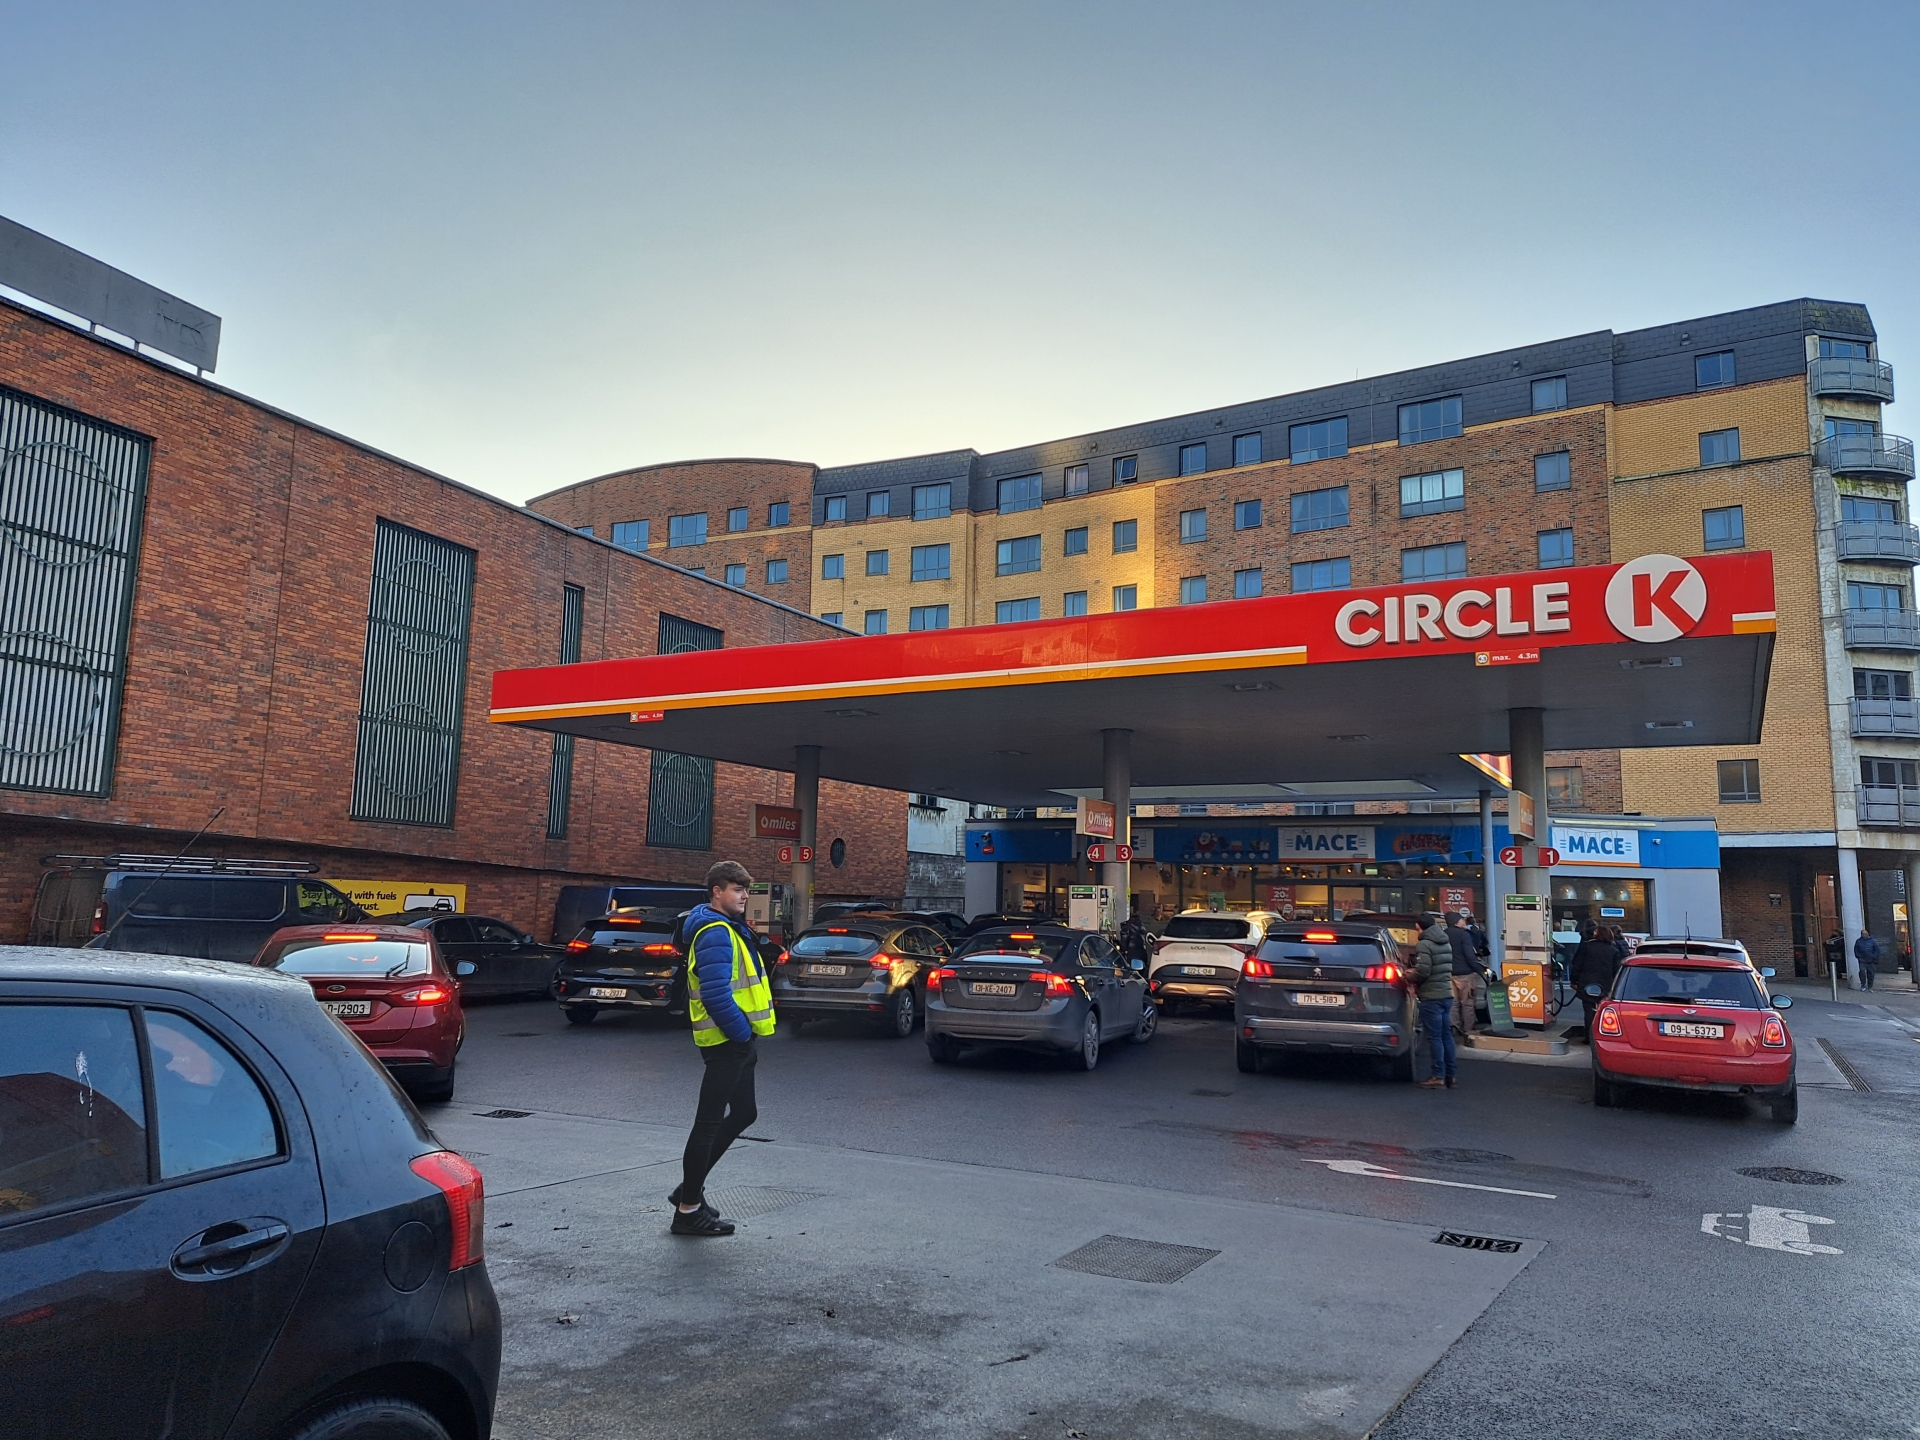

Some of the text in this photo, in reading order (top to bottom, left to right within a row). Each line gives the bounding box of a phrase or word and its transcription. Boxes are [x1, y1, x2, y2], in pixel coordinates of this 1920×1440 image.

[1335, 569, 1698, 646] CIRCLE K
[1518, 652, 1538, 660] 4.3m
[1295, 834, 1358, 851] MACE
[1568, 835, 1625, 855] MACE
[781, 849, 788, 860] 6
[803, 848, 810, 860] 5
[1091, 847, 1100, 859] 4
[1120, 847, 1129, 859] 3
[1505, 850, 1516, 864] 2
[1546, 850, 1554, 864] 1
[302, 890, 323, 900] Stay
[354, 890, 375, 900] with
[377, 891, 397, 901] fuels
[358, 901, 379, 911] trust.
[975, 984, 1013, 994] 131-KE-2407
[1508, 986, 1539, 1003] 3%
[1303, 994, 1338, 1004] 171-L-5183
[1670, 1024, 1717, 1036] 09-L-6373
